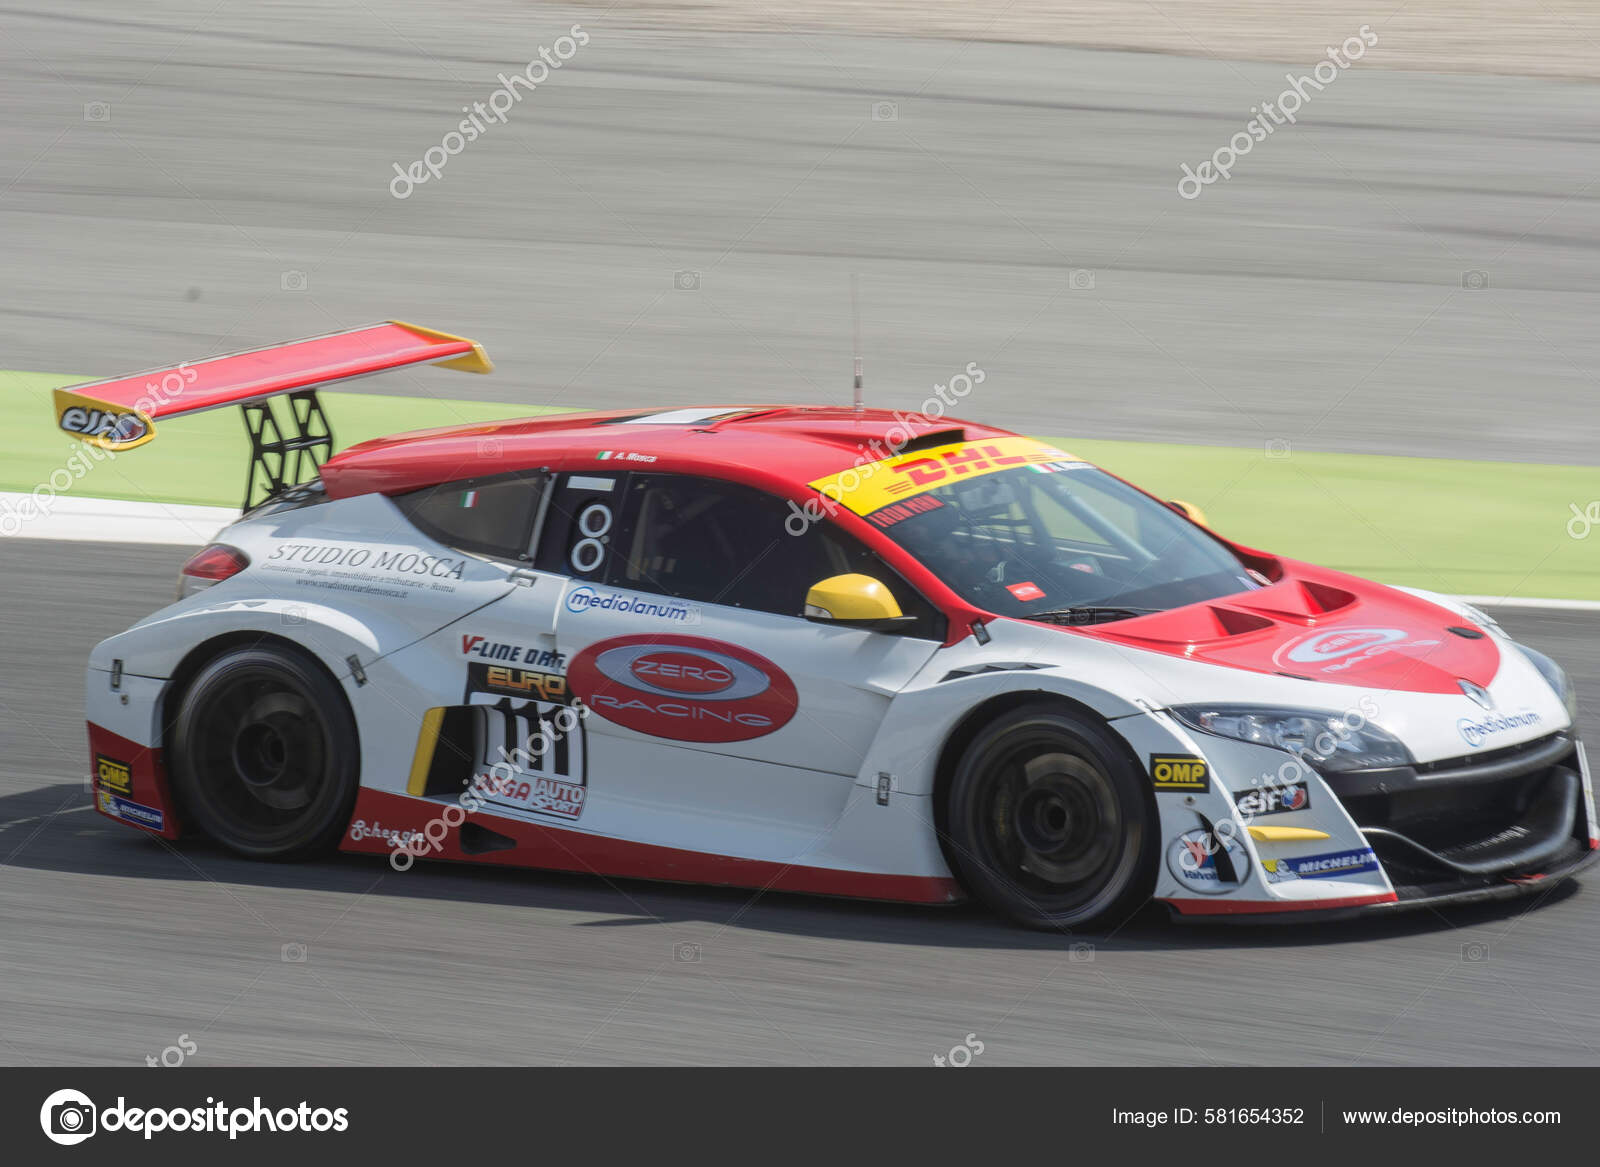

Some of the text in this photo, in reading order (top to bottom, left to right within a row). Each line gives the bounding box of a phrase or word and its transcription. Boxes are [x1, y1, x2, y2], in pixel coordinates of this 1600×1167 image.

[892, 446, 1027, 486] DHL
[268, 544, 467, 580] STUDIO MOSCA
[570, 592, 687, 621] mediolanum
[487, 665, 567, 700] EURO
[635, 660, 732, 683] ZERO
[591, 694, 773, 727] RACING
[98, 764, 130, 787] OMP
[1154, 763, 1206, 783] OMP
[535, 779, 581, 804] AUTO
[1299, 853, 1377, 873] MICHELIN
